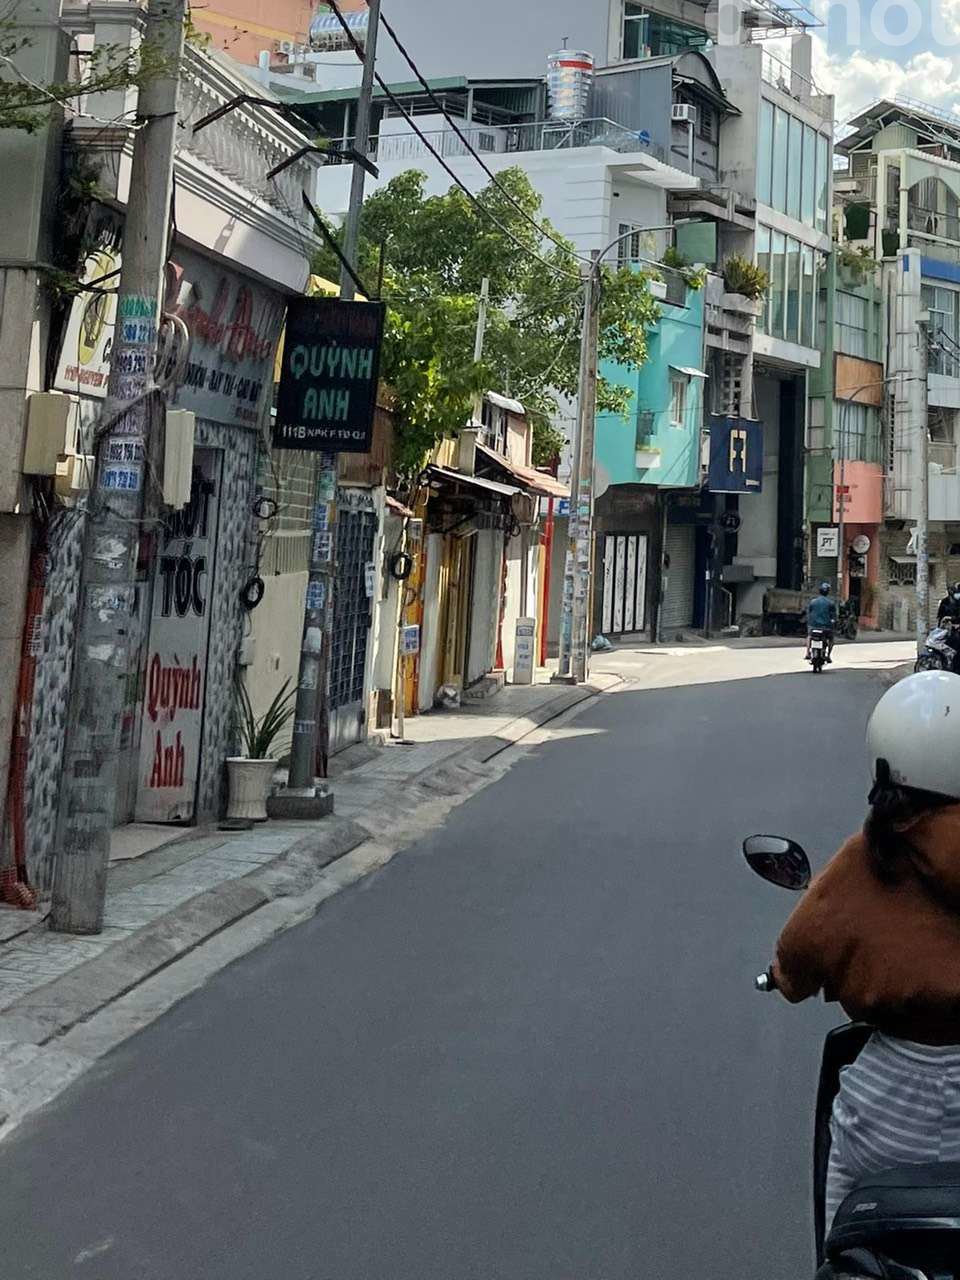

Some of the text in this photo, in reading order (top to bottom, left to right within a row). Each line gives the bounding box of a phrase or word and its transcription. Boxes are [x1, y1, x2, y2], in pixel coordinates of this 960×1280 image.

[302, 387, 350, 421] ANH
[148, 652, 201, 722] Quỳnh
[150, 730, 185, 788] Anh
